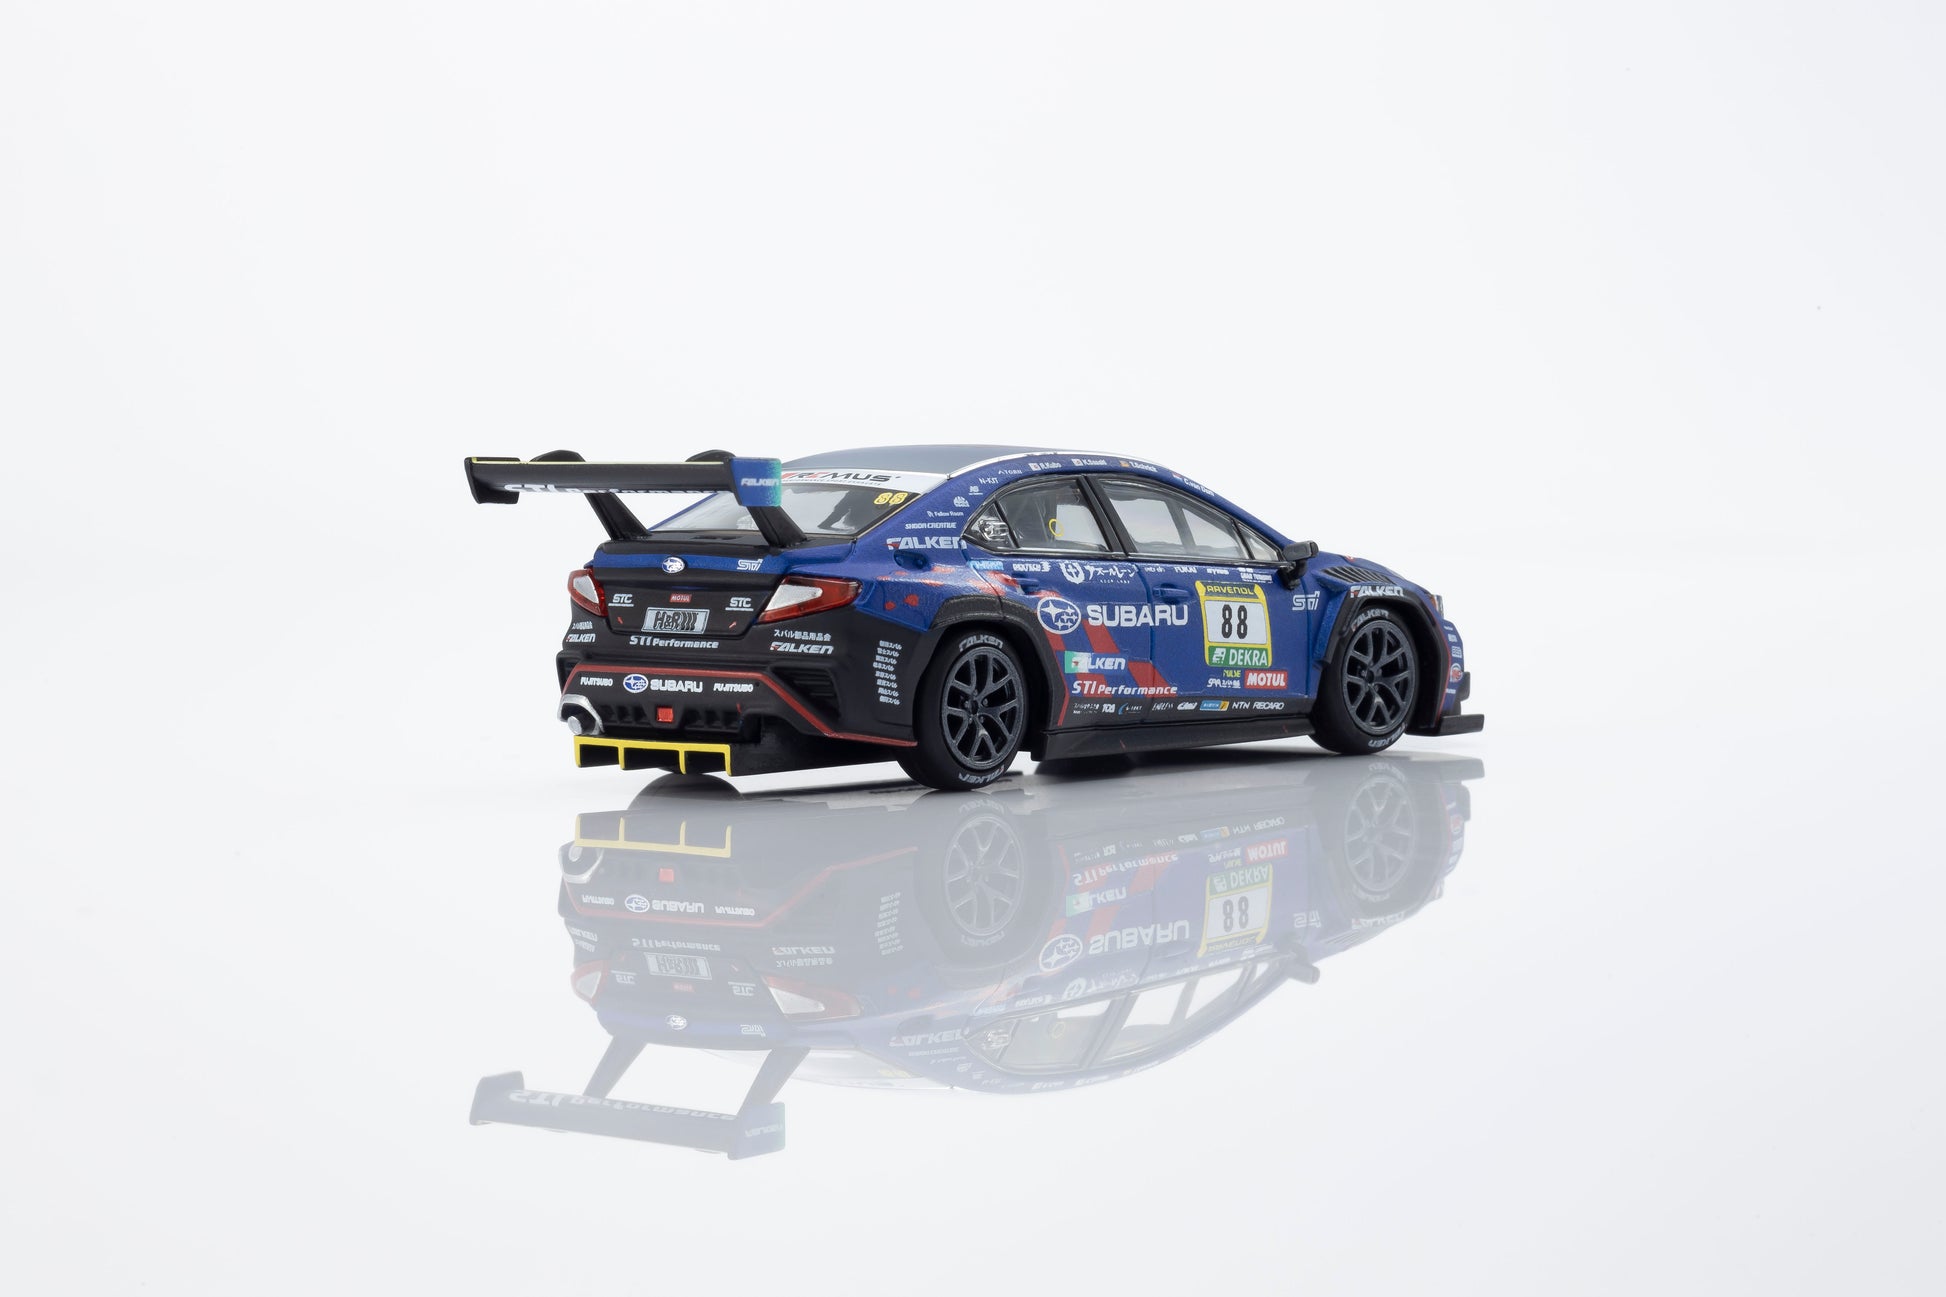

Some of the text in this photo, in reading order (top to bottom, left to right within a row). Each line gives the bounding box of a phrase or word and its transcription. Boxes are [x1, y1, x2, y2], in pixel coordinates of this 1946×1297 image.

[874, 492, 909, 505] 88
[886, 536, 968, 550] FALKEN
[1206, 585, 1255, 595] RAVENOL
[1350, 585, 1405, 598] FALKEN
[1086, 604, 1189, 627] SUBARU
[1221, 604, 1248, 639] 88
[566, 633, 596, 642] FALKEN
[653, 638, 719, 648] Performance
[959, 634, 1004, 651] FALKEN
[770, 642, 834, 654] FALKEN
[1072, 656, 1126, 670] FALKEN
[1229, 648, 1268, 666] DEKRA
[650, 678, 703, 692] SUBARU
[1246, 672, 1286, 687] MOTUL
[1072, 681, 1178, 695] STI Performance
[1253, 702, 1285, 710] RECARO
